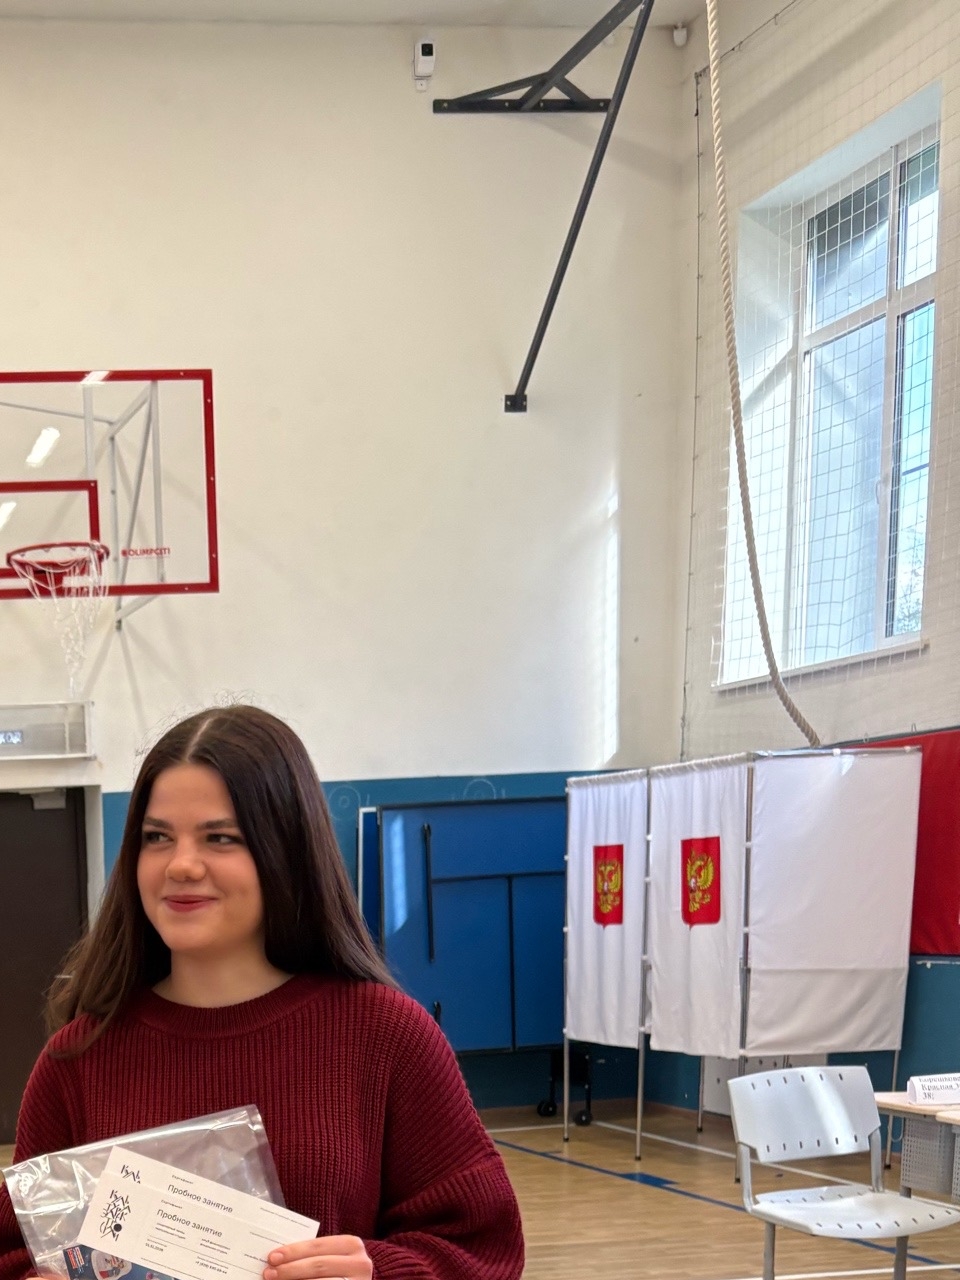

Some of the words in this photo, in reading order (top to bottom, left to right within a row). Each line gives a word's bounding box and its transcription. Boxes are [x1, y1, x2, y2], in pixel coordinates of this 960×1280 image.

[167, 1184, 202, 1202] Пробное
[202, 1197, 234, 1213] занятие
[156, 1209, 191, 1227] Пробное
[191, 1222, 223, 1238] занятие
